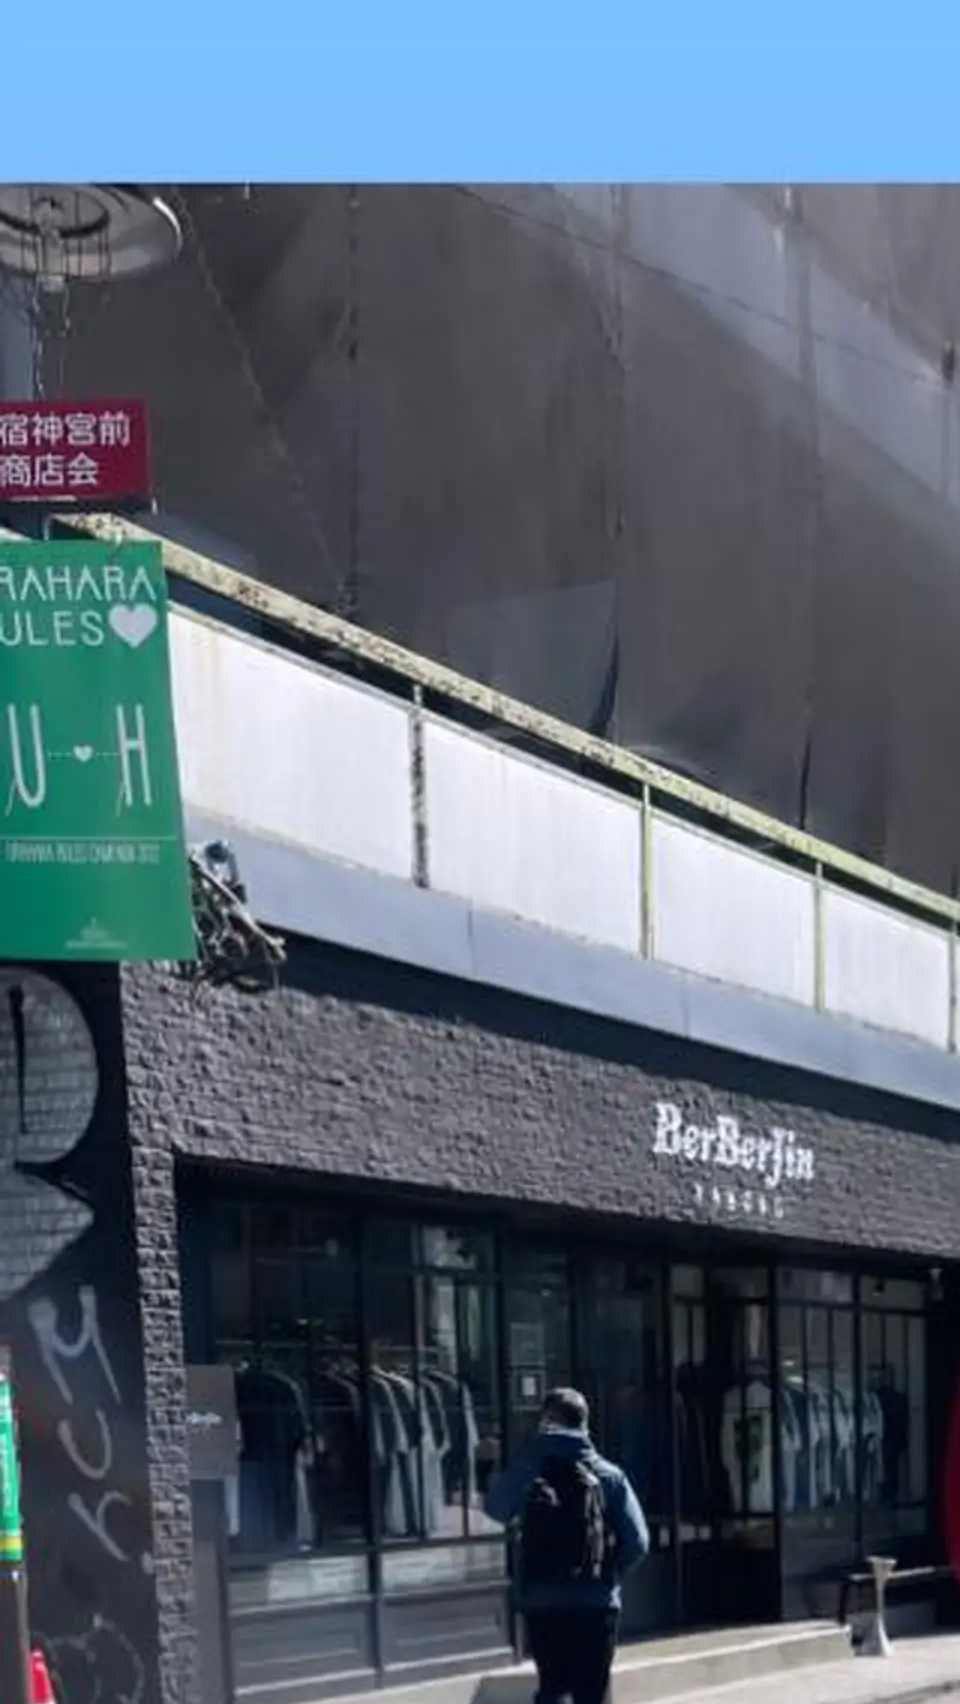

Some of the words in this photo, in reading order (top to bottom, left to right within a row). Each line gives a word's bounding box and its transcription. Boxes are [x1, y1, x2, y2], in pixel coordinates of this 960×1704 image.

[0, 411, 130, 447] 宿神宮前
[0, 452, 98, 487] 商店会
[0, 565, 157, 601] RAHARA
[0, 610, 105, 646] ULES
[6, 703, 46, 808] U
[116, 703, 152, 808] H
[653, 1102, 815, 1188] BerBerJin
